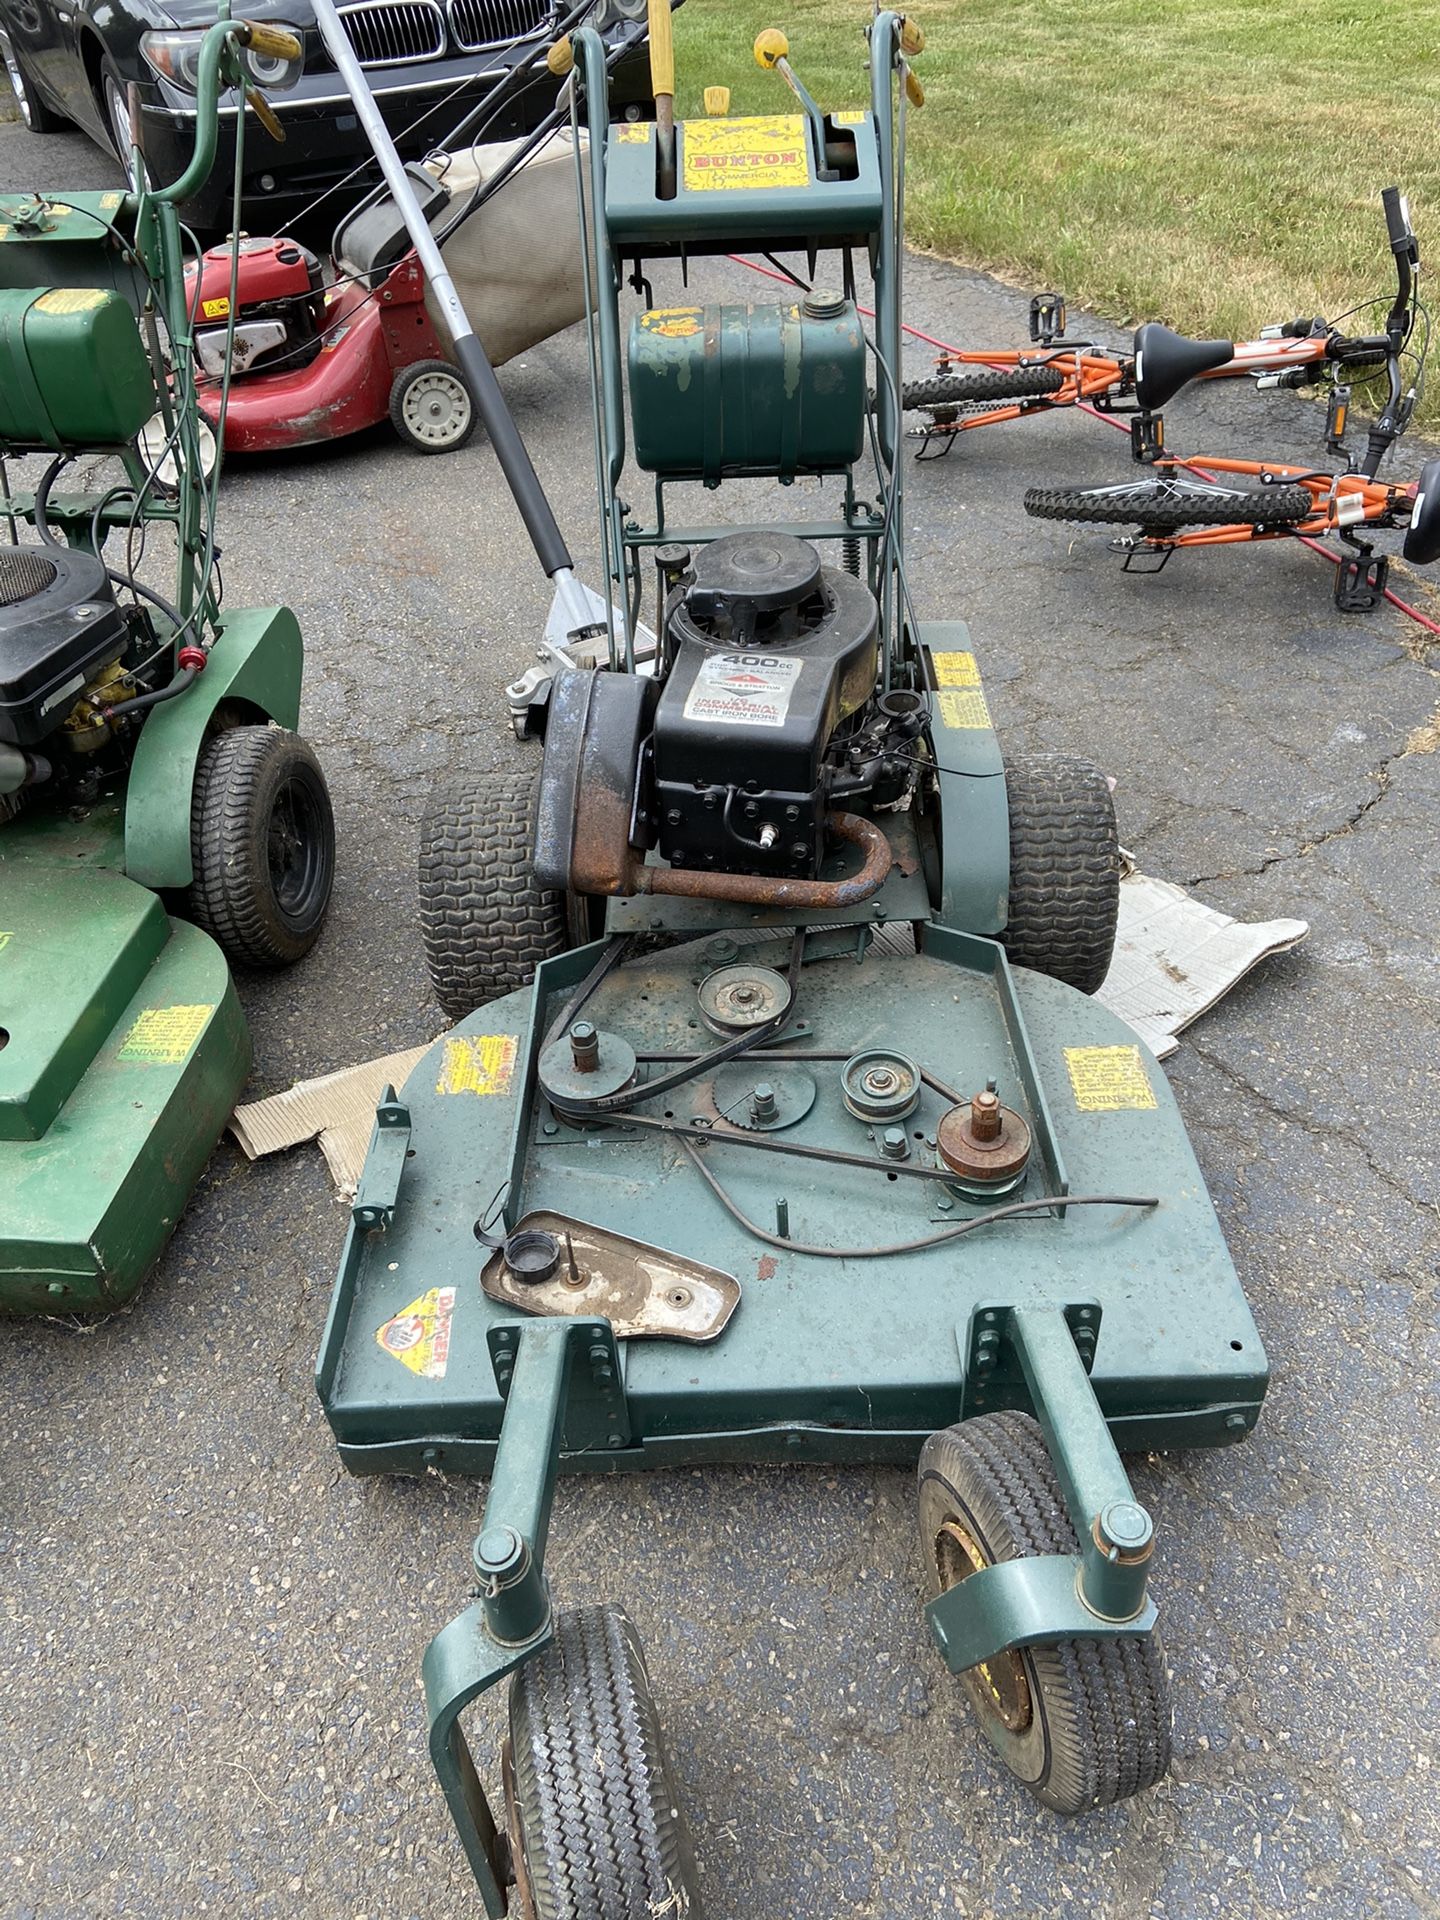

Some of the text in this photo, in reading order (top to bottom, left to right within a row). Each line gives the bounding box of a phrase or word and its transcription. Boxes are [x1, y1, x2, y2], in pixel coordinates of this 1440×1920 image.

[693, 152, 797, 168] BUNTON
[712, 171, 780, 183] COMMERCIAL
[709, 680, 736, 688] BRIGGS
[744, 683, 781, 691] STRATTON
[694, 702, 779, 714] COMMERCIAL
[697, 698, 776, 710] INDUSTRIAL
[692, 707, 720, 715] CAST
[750, 713, 779, 721] BORE
